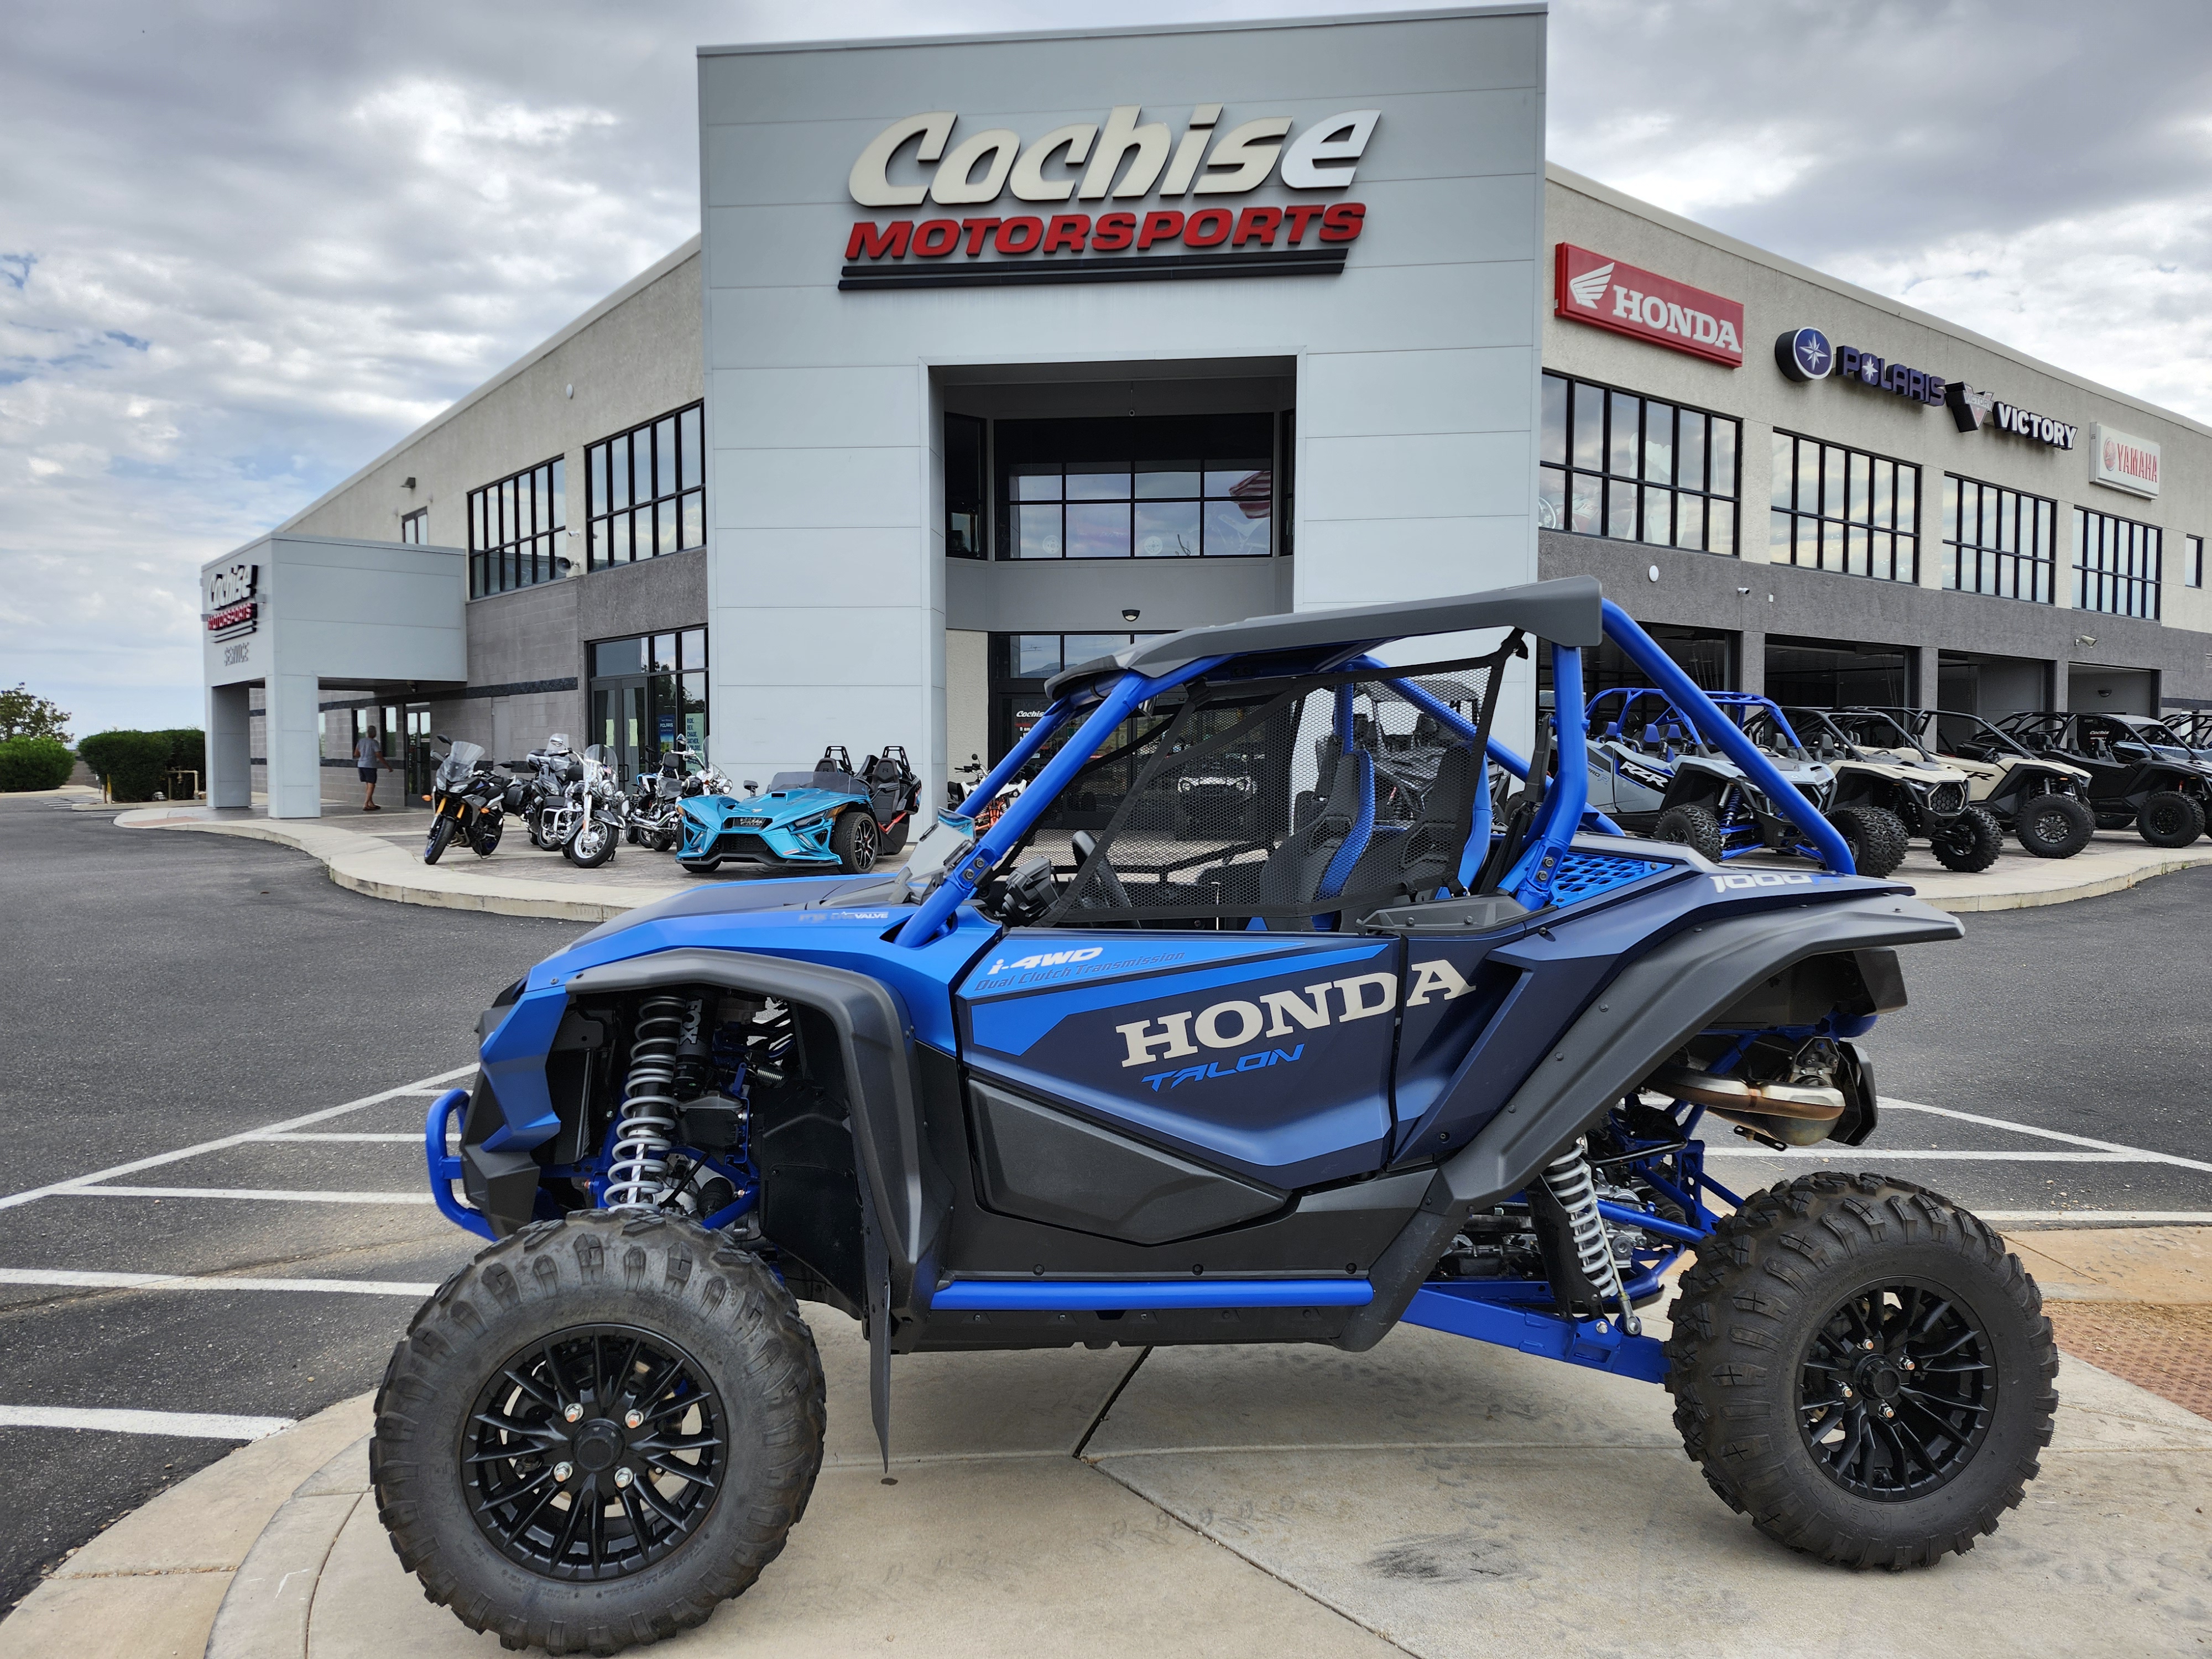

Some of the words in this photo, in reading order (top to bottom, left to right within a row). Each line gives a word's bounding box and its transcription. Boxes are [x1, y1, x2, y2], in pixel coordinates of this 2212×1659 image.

[848, 103, 1381, 206] Cochise
[844, 203, 1366, 260] MOTORSPORTS
[1612, 284, 1742, 354] HONDA
[1837, 345, 1946, 408] POLARIS
[1994, 401, 2078, 451] VICTORY
[2117, 443, 2158, 483] YAMAHA
[207, 565, 258, 611] Cochise
[1620, 761, 1669, 788] RZR
[974, 976, 1014, 992] Dual
[1018, 968, 1071, 985] Clutch
[1075, 952, 1186, 975] Transmission
[987, 947, 1104, 975] i-4WD
[679, 999, 703, 1046] FOX
[1116, 959, 1477, 1067] HONDA
[1141, 1044, 1305, 1092] TALON
